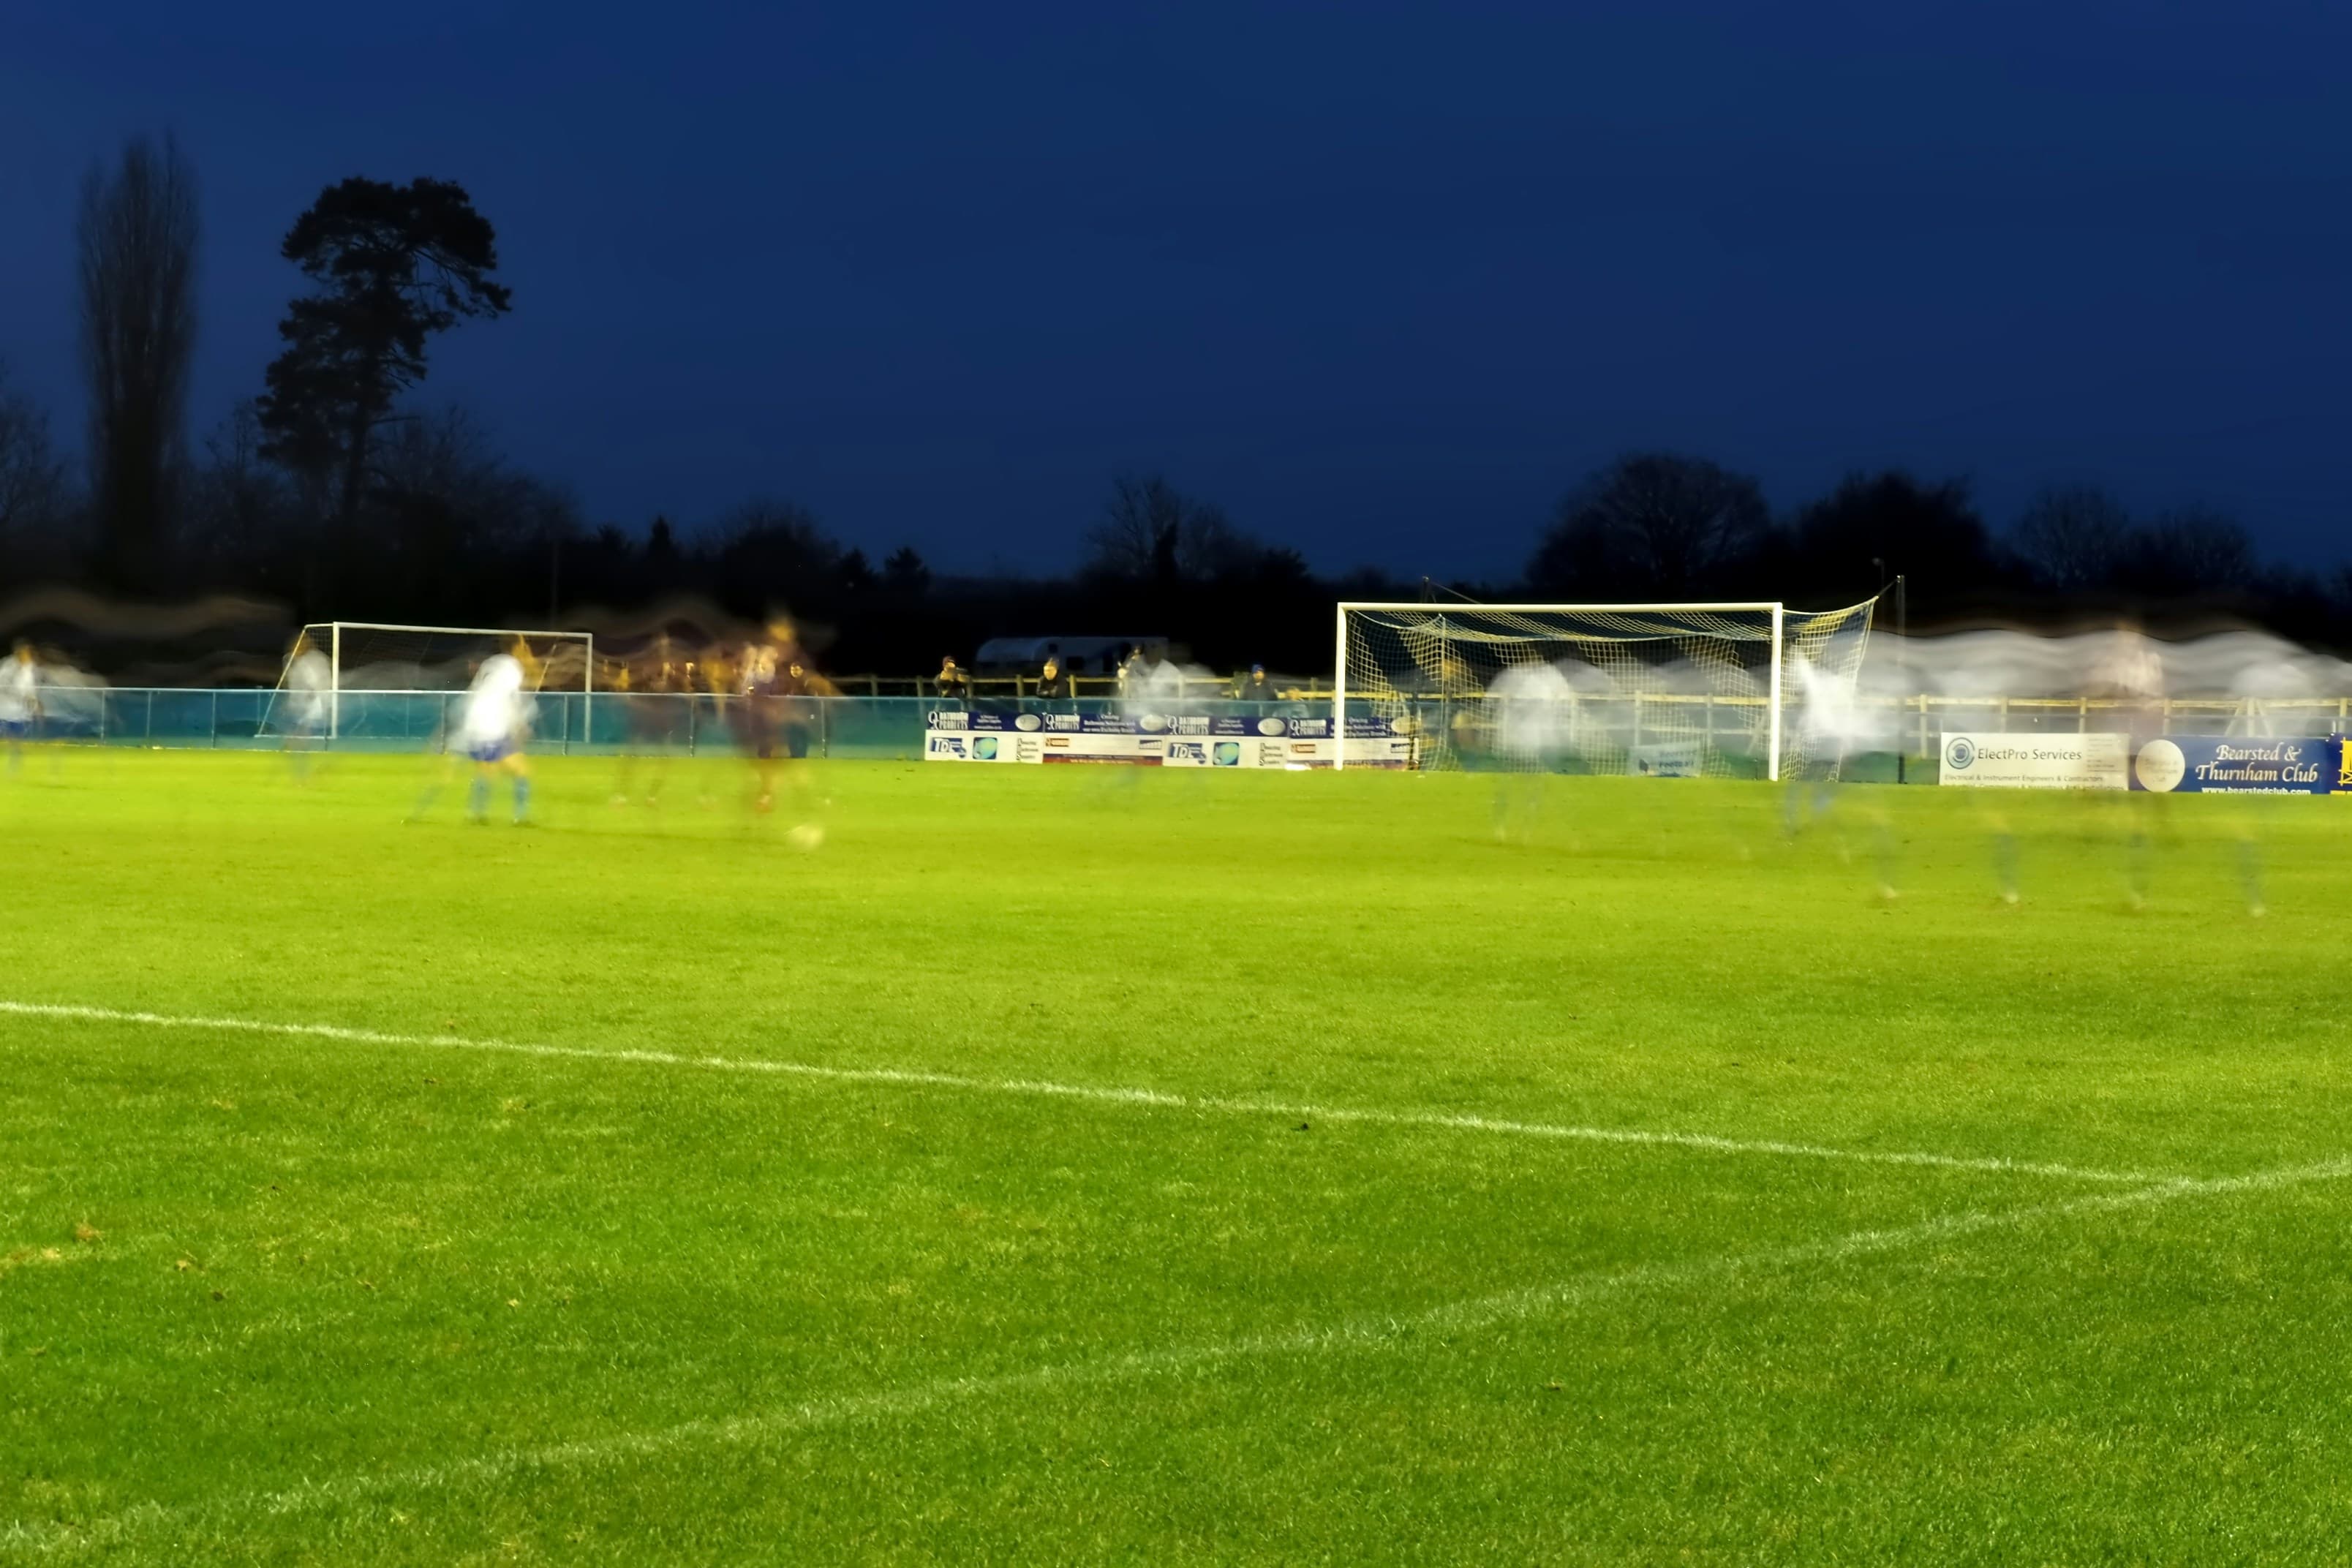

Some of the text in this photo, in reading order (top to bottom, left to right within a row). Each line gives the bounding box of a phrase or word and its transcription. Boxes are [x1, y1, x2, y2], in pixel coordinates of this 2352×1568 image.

[1978, 748, 2082, 760] ElectPro Services
[2216, 742, 2302, 761] Bearsted &
[2195, 761, 2278, 781] Thurnham
[2283, 763, 2318, 783] Club
[2201, 786, 2311, 795] www.bearstedclub.com
